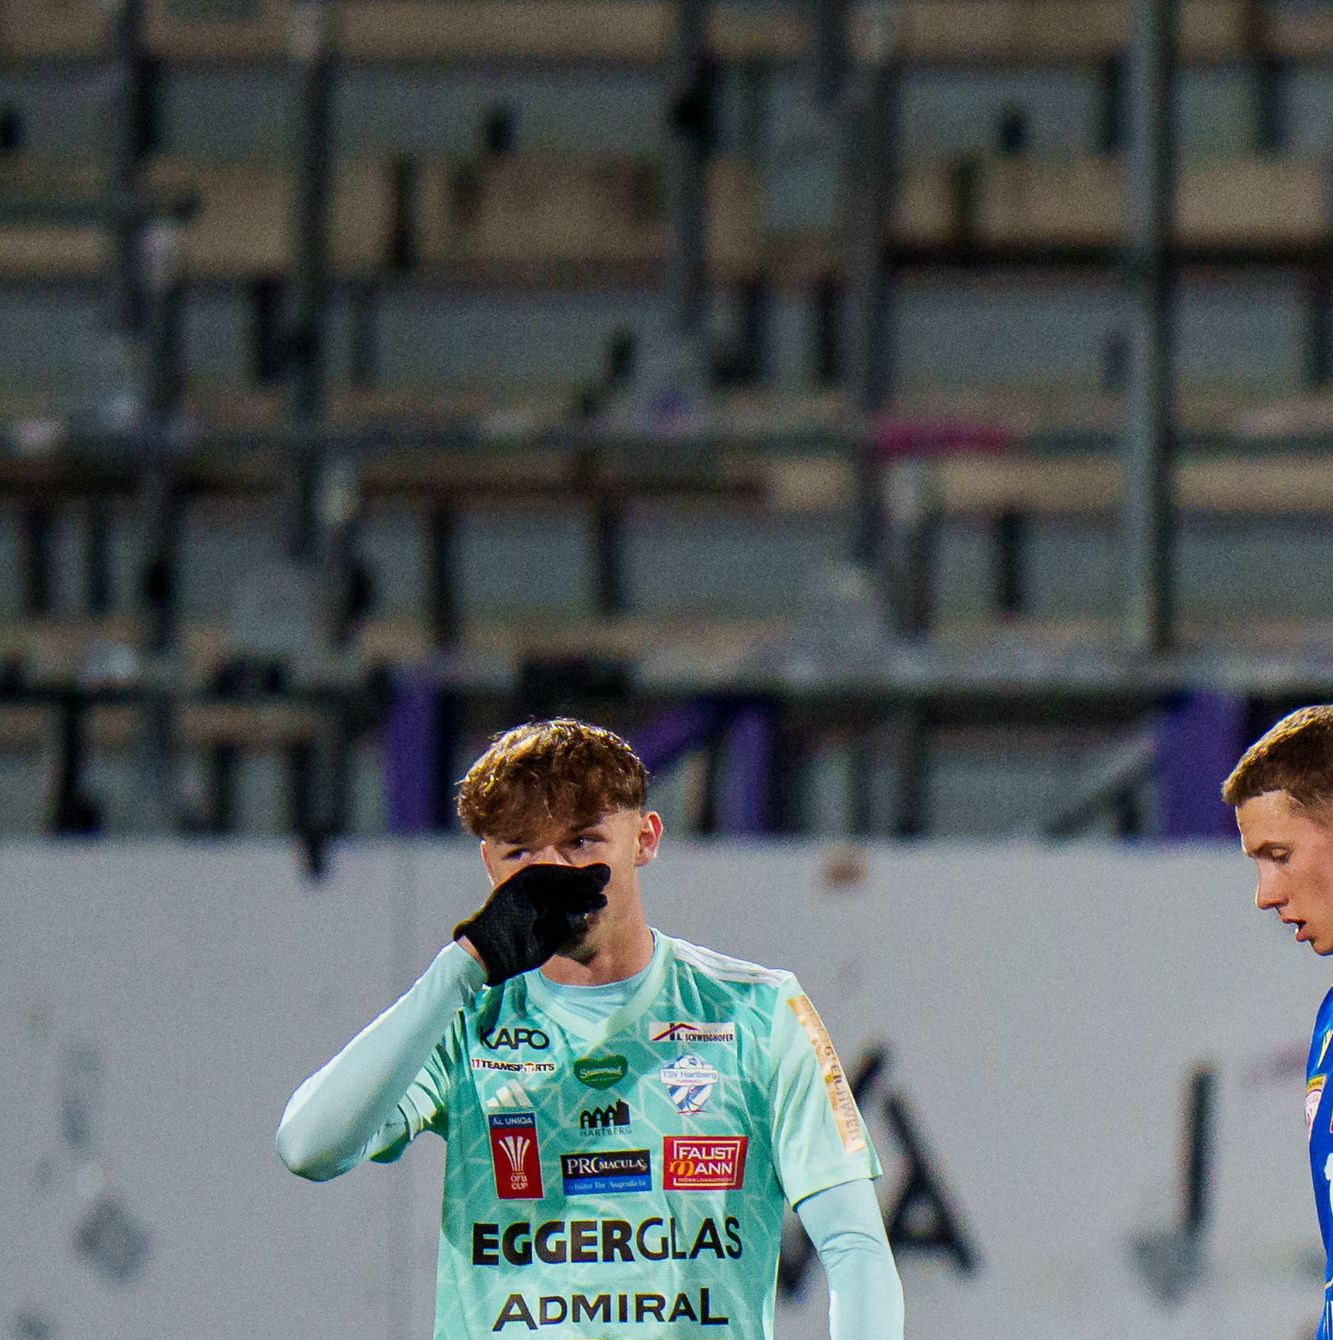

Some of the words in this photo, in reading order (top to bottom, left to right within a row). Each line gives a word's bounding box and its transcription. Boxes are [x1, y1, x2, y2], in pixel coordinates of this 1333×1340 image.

[479, 1026, 550, 1050] KAPO
[580, 1127, 632, 1138] HARTBERG
[679, 1146, 736, 1160] FAUST
[472, 1215, 744, 1266] EGGERGLAS
[492, 1287, 729, 1333] ADMIRAL
